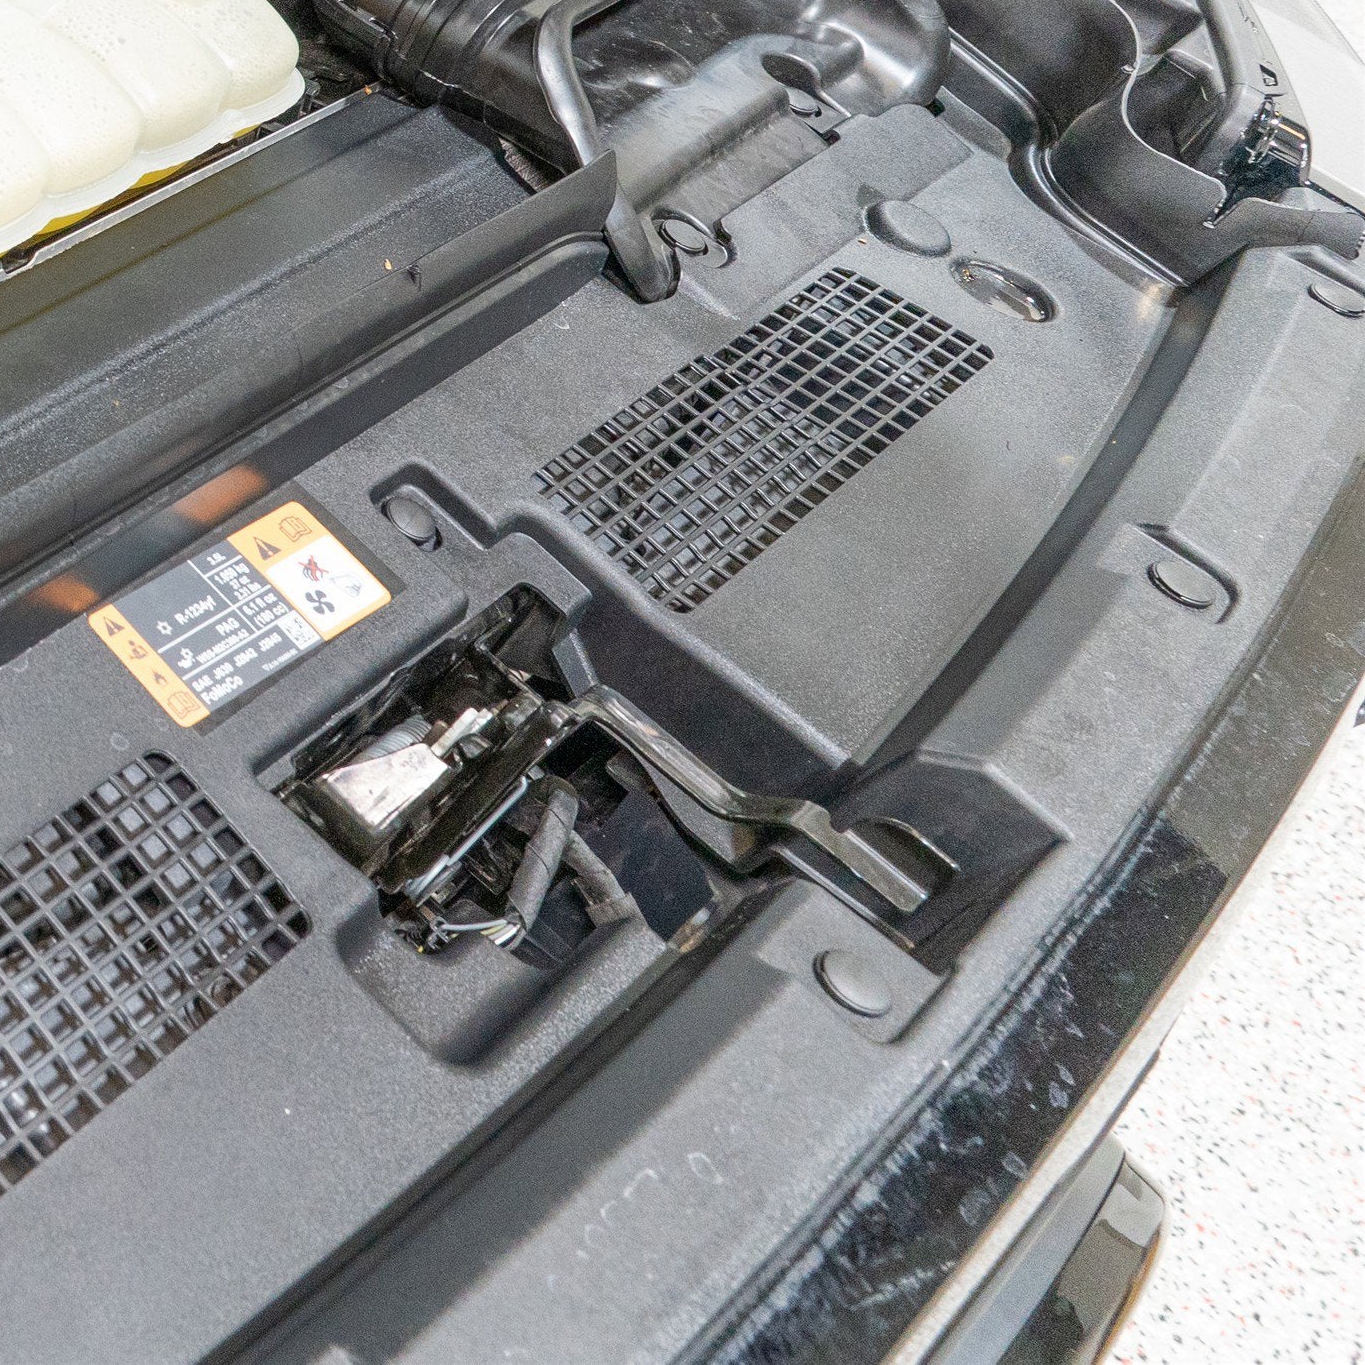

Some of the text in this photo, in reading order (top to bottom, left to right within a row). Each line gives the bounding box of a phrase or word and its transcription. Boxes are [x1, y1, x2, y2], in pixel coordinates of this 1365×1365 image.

[232, 560, 251, 576] kg
[228, 575, 251, 590] 37 oz
[232, 579, 262, 600] 2.31 lbs
[172, 594, 220, 627] R-1234yf
[240, 591, 278, 616] 6.1 fl oz
[269, 600, 290, 618] cc)
[214, 616, 241, 636] PAG
[190, 673, 215, 693] SAE
[209, 660, 235, 681] J639
[199, 672, 245, 705] FoMoCo
